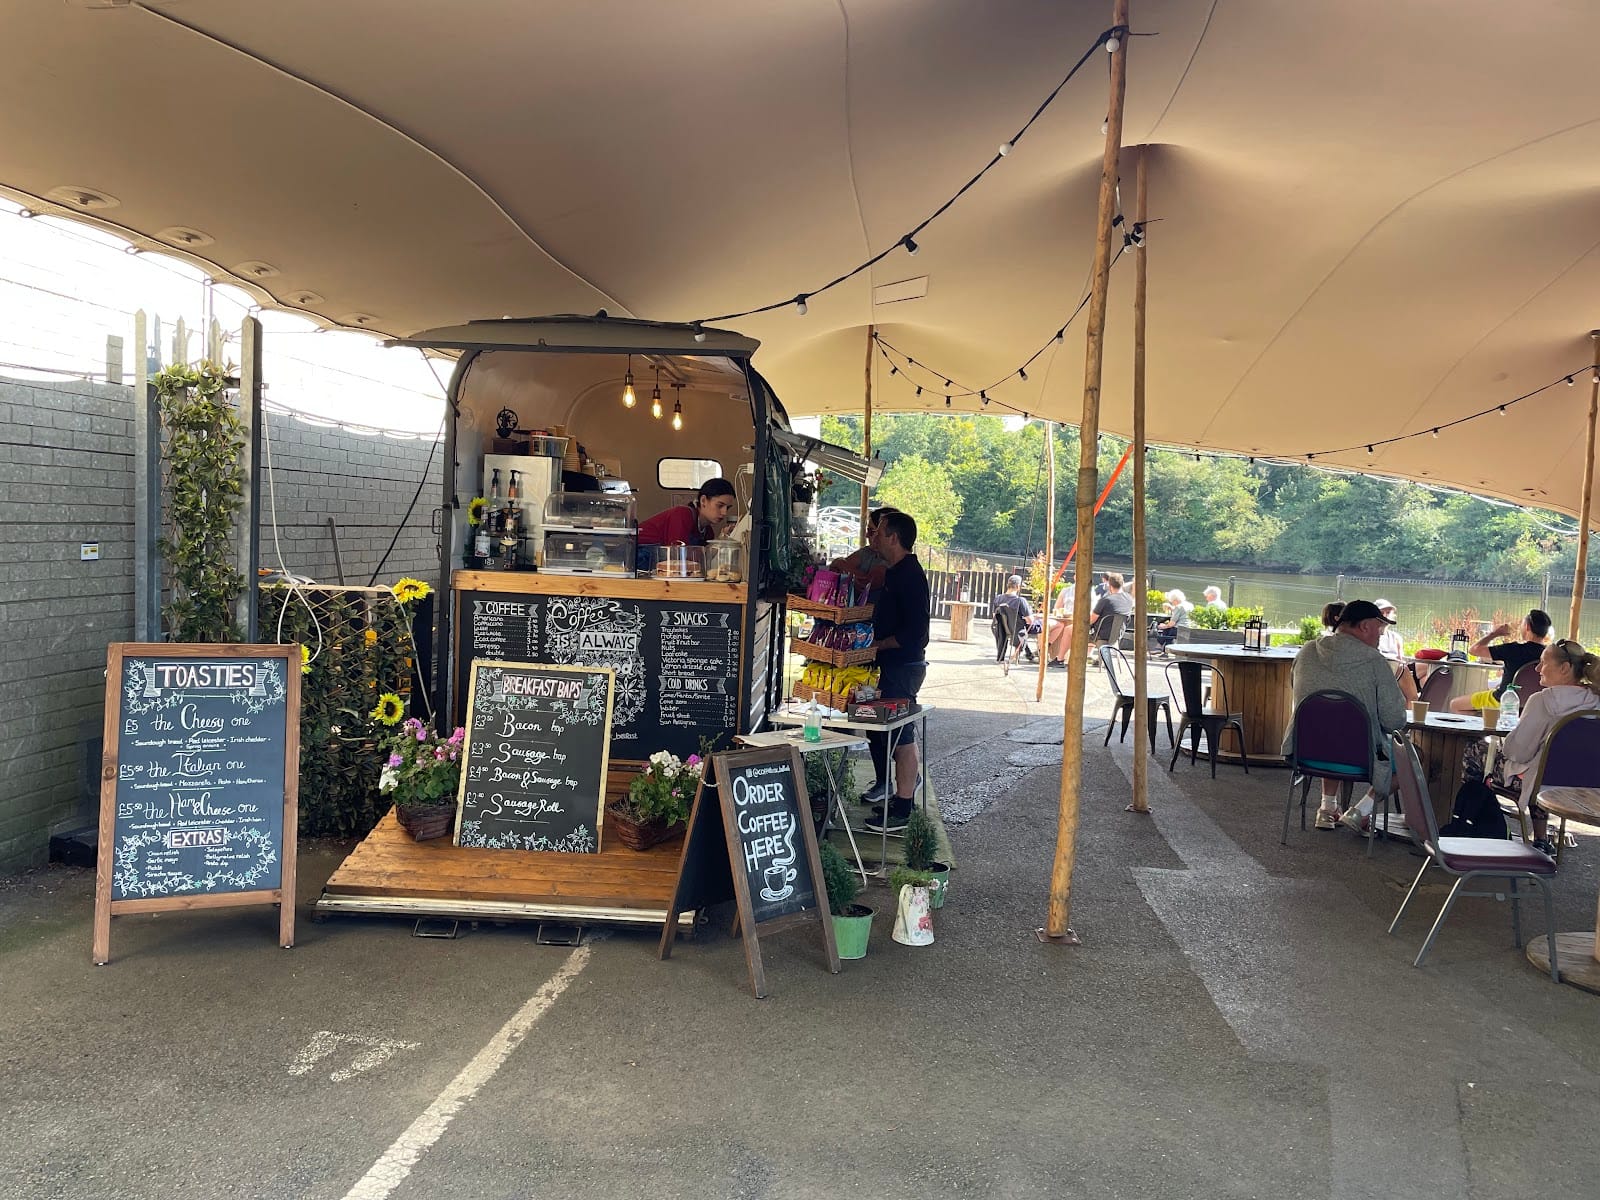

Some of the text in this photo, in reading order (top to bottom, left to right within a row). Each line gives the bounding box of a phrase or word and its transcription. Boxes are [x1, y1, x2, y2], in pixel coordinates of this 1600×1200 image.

[474, 614, 504, 622] Americano
[486, 602, 526, 616] COFFEE
[551, 601, 610, 632] Coffee
[674, 612, 708, 625] SNACKS
[474, 641, 501, 650] Espresso
[554, 635, 635, 650] is ALWAYS
[157, 665, 254, 688] TOASTIES
[502, 675, 583, 699] BREAKFAST BAPS
[667, 678, 708, 690] COLD DRINKS
[125, 703, 251, 733] £5 the Cheesy one
[496, 713, 542, 738] Bacon
[550, 720, 565, 737] bap
[147, 760, 171, 777] the
[173, 751, 222, 775] Italian
[226, 761, 246, 770] one
[490, 743, 551, 764] Sausage
[552, 748, 567, 765] bap
[565, 777, 579, 791] bap
[732, 775, 785, 806] ORDER
[143, 801, 168, 819] the
[238, 803, 260, 813] one
[480, 793, 539, 818] Sausage
[533, 798, 565, 820] Roll
[737, 809, 790, 834] COFFEE
[172, 830, 222, 847] EXTRAS
[744, 834, 785, 873] HERE
